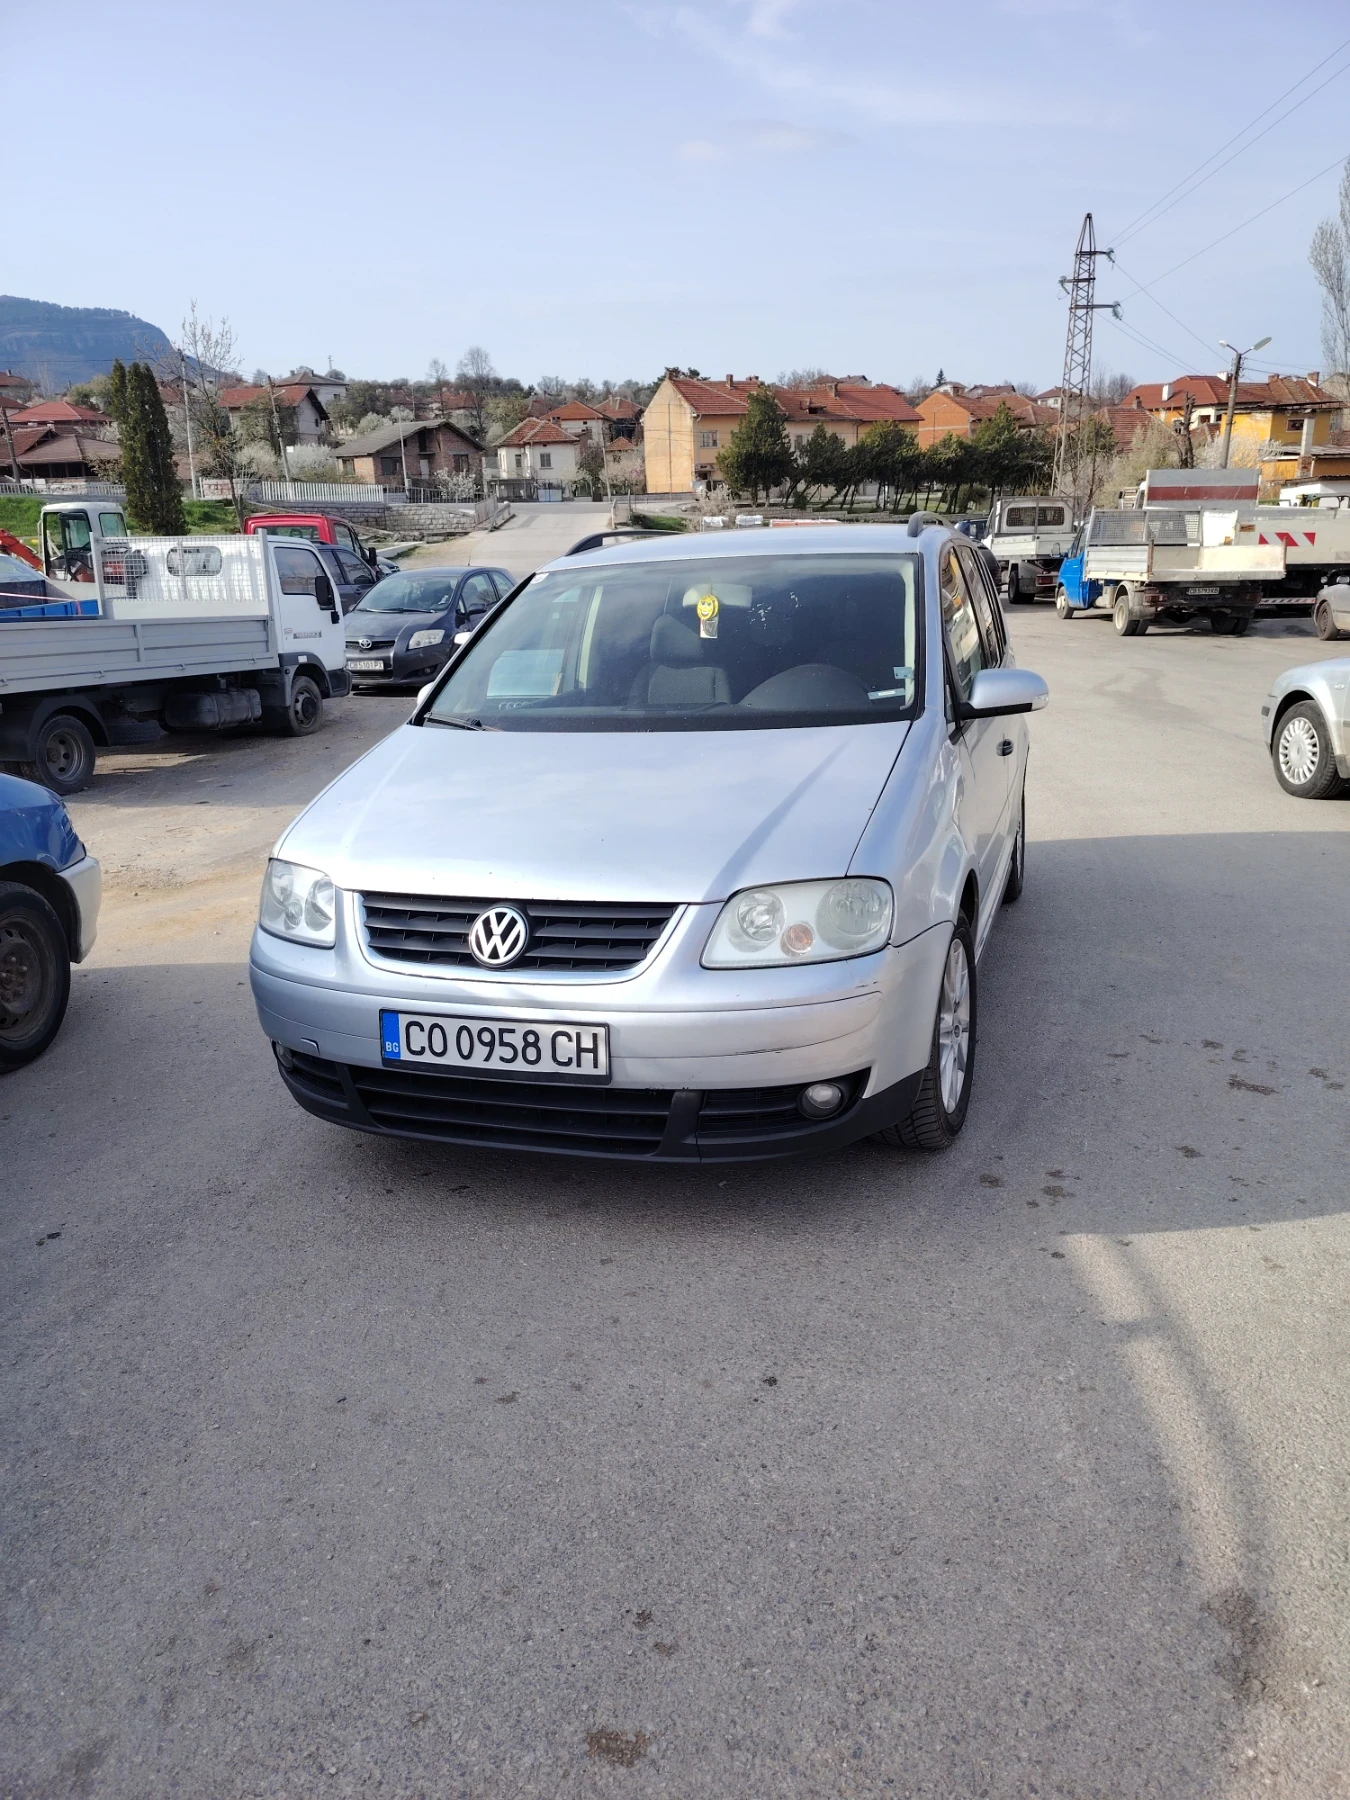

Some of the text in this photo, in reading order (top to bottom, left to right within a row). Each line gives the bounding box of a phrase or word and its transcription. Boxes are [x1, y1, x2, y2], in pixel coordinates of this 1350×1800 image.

[471, 907, 526, 965] VW
[385, 1041, 399, 1053] BG
[404, 1020, 599, 1069] CO 0958 CH
